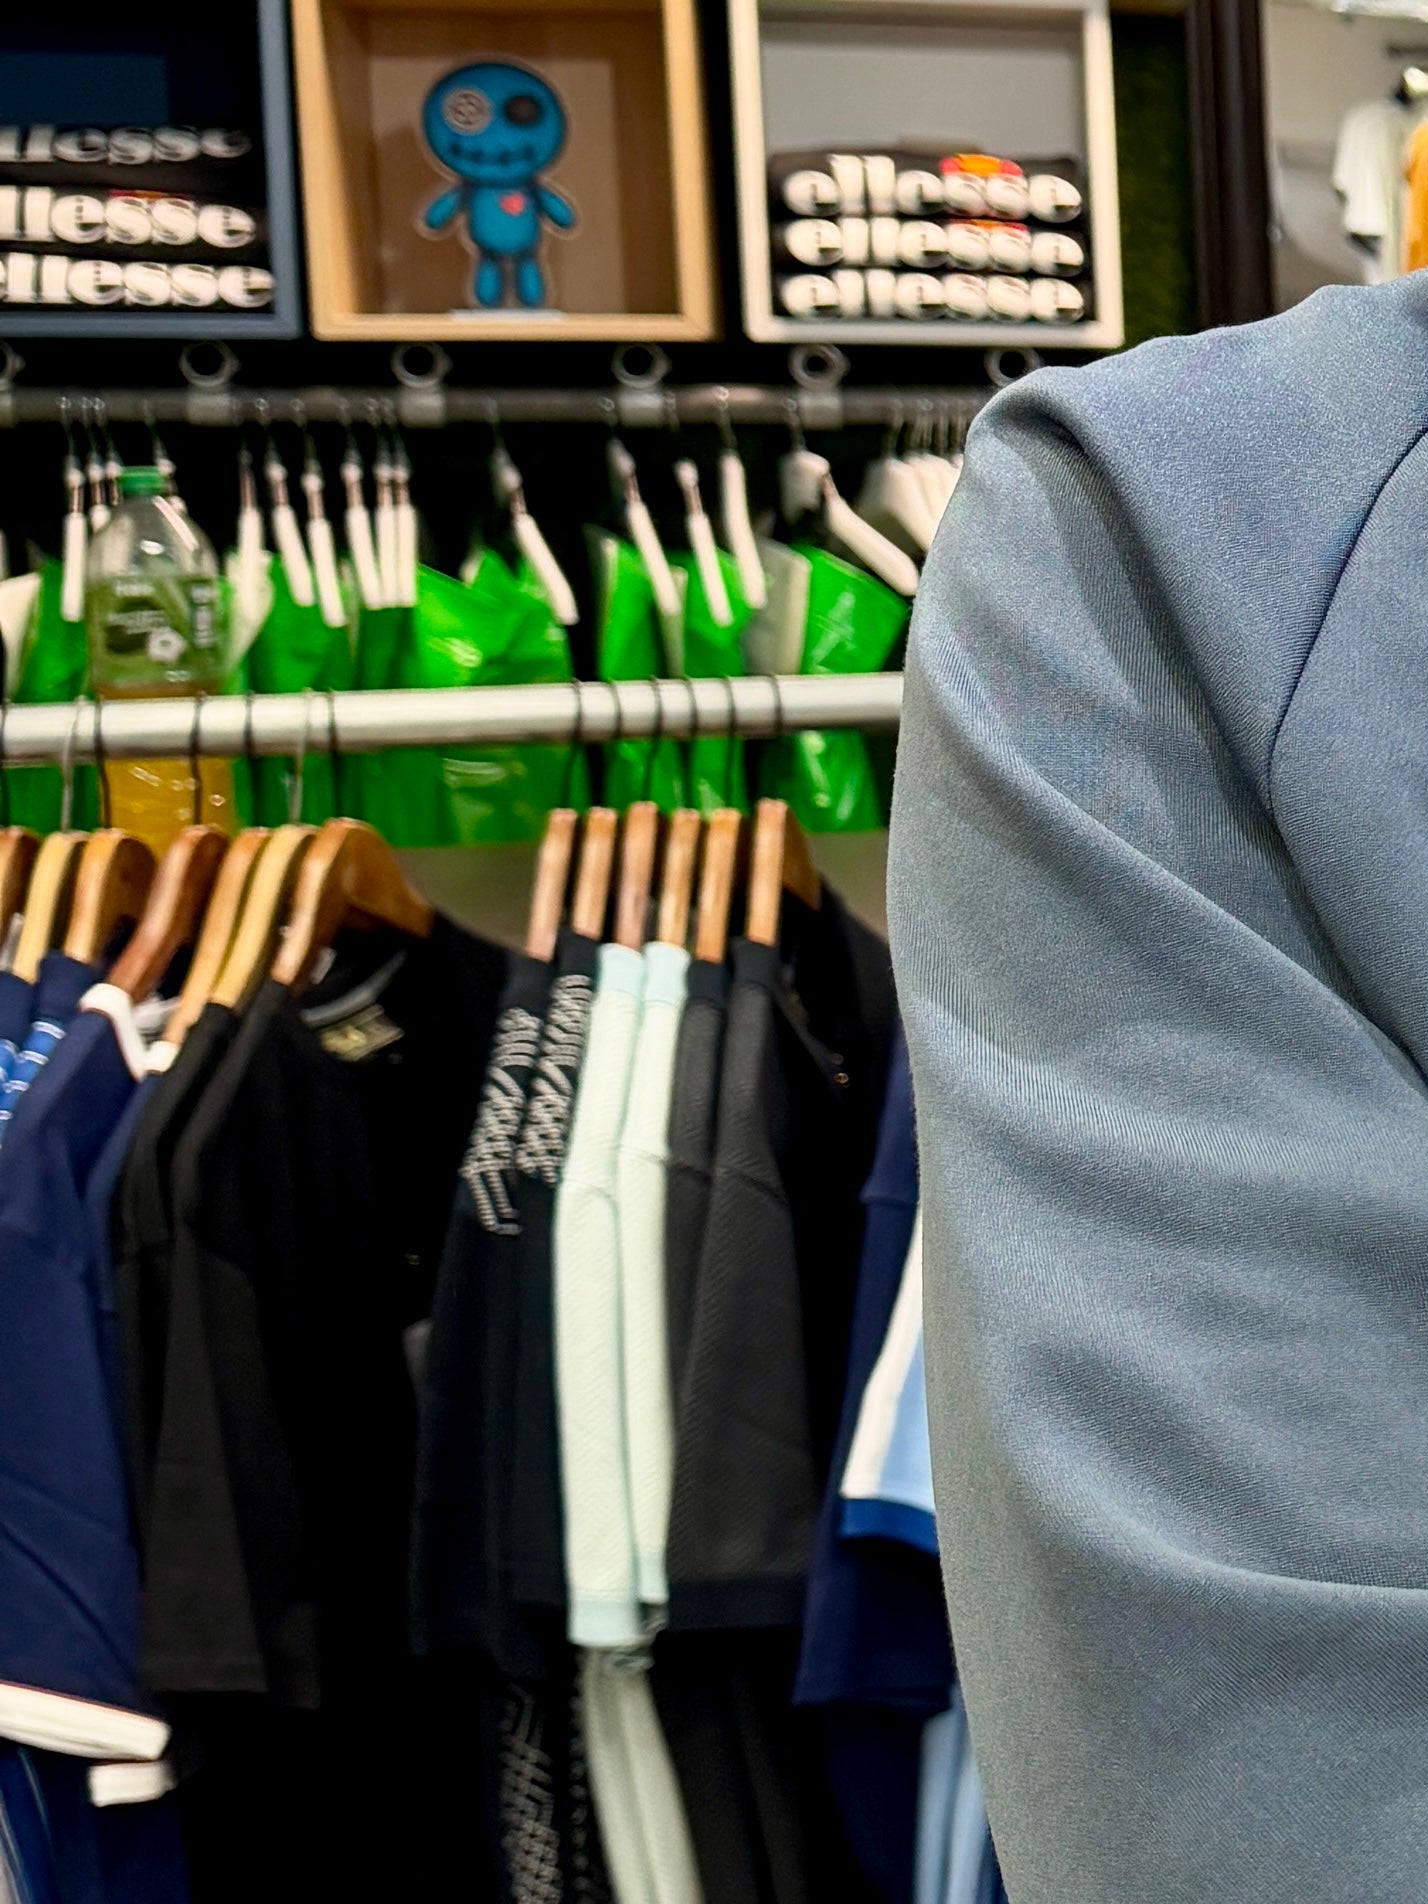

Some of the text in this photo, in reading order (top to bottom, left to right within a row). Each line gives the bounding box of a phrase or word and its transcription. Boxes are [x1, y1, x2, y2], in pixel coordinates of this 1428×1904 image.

[783, 154, 1082, 223] ellesse
[784, 216, 1084, 277] ellesse
[0, 252, 275, 308] llesse
[781, 269, 1084, 324] ellesse
